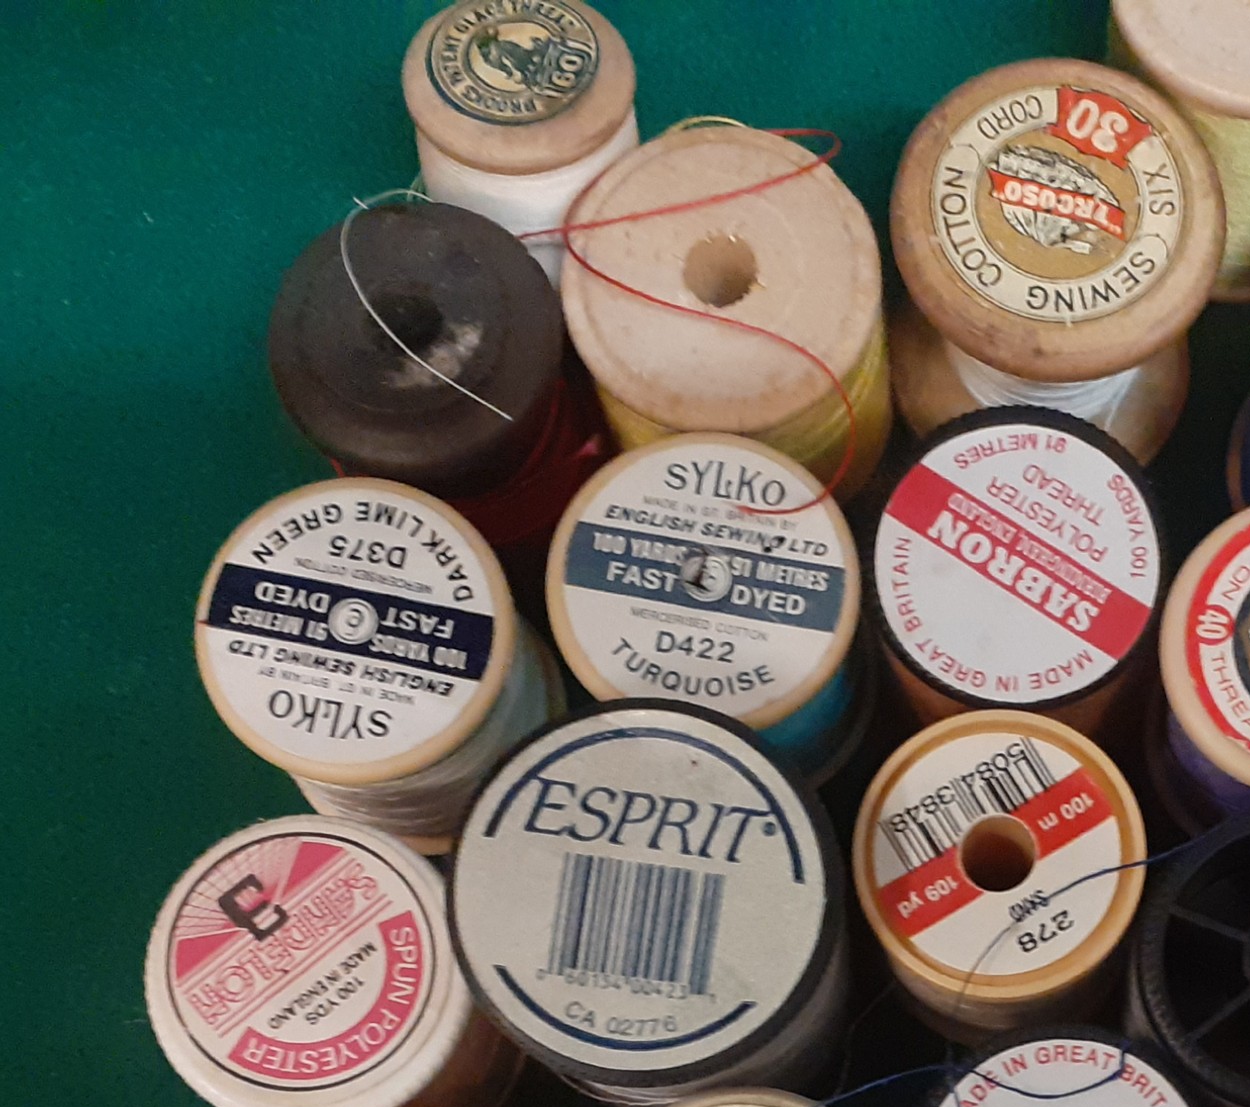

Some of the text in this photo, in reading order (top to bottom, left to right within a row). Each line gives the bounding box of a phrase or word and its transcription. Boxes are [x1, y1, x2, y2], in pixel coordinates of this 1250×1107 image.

[977, 95, 1042, 139] CORD
[1066, 99, 1128, 153] 30
[1142, 163, 1174, 215] SIX
[940, 165, 1154, 312] SEWING COTTON
[663, 461, 785, 506] SYLKO
[1022, 464, 1103, 526] THREAD
[985, 476, 1107, 561] POLYESTER
[251, 501, 472, 601] DARK LIME GREEN
[328, 535, 406, 568] D375
[926, 509, 1099, 631] SABRON
[253, 581, 454, 638] FAST DYED
[606, 562, 806, 615] FAST DYED
[655, 630, 735, 662] D422
[1195, 612, 1232, 645] 40
[611, 638, 775, 697] TURQUOISE
[268, 689, 392, 739] SYLKO
[1037, 792, 1094, 830] 100 m
[897, 875, 959, 918] 109 yd
[1017, 910, 1074, 952] 278
[244, 926, 417, 1073] SPUN POLYESTER
[565, 1001, 678, 1035] CA 02776
[1035, 1045, 1116, 1070] GREAT
